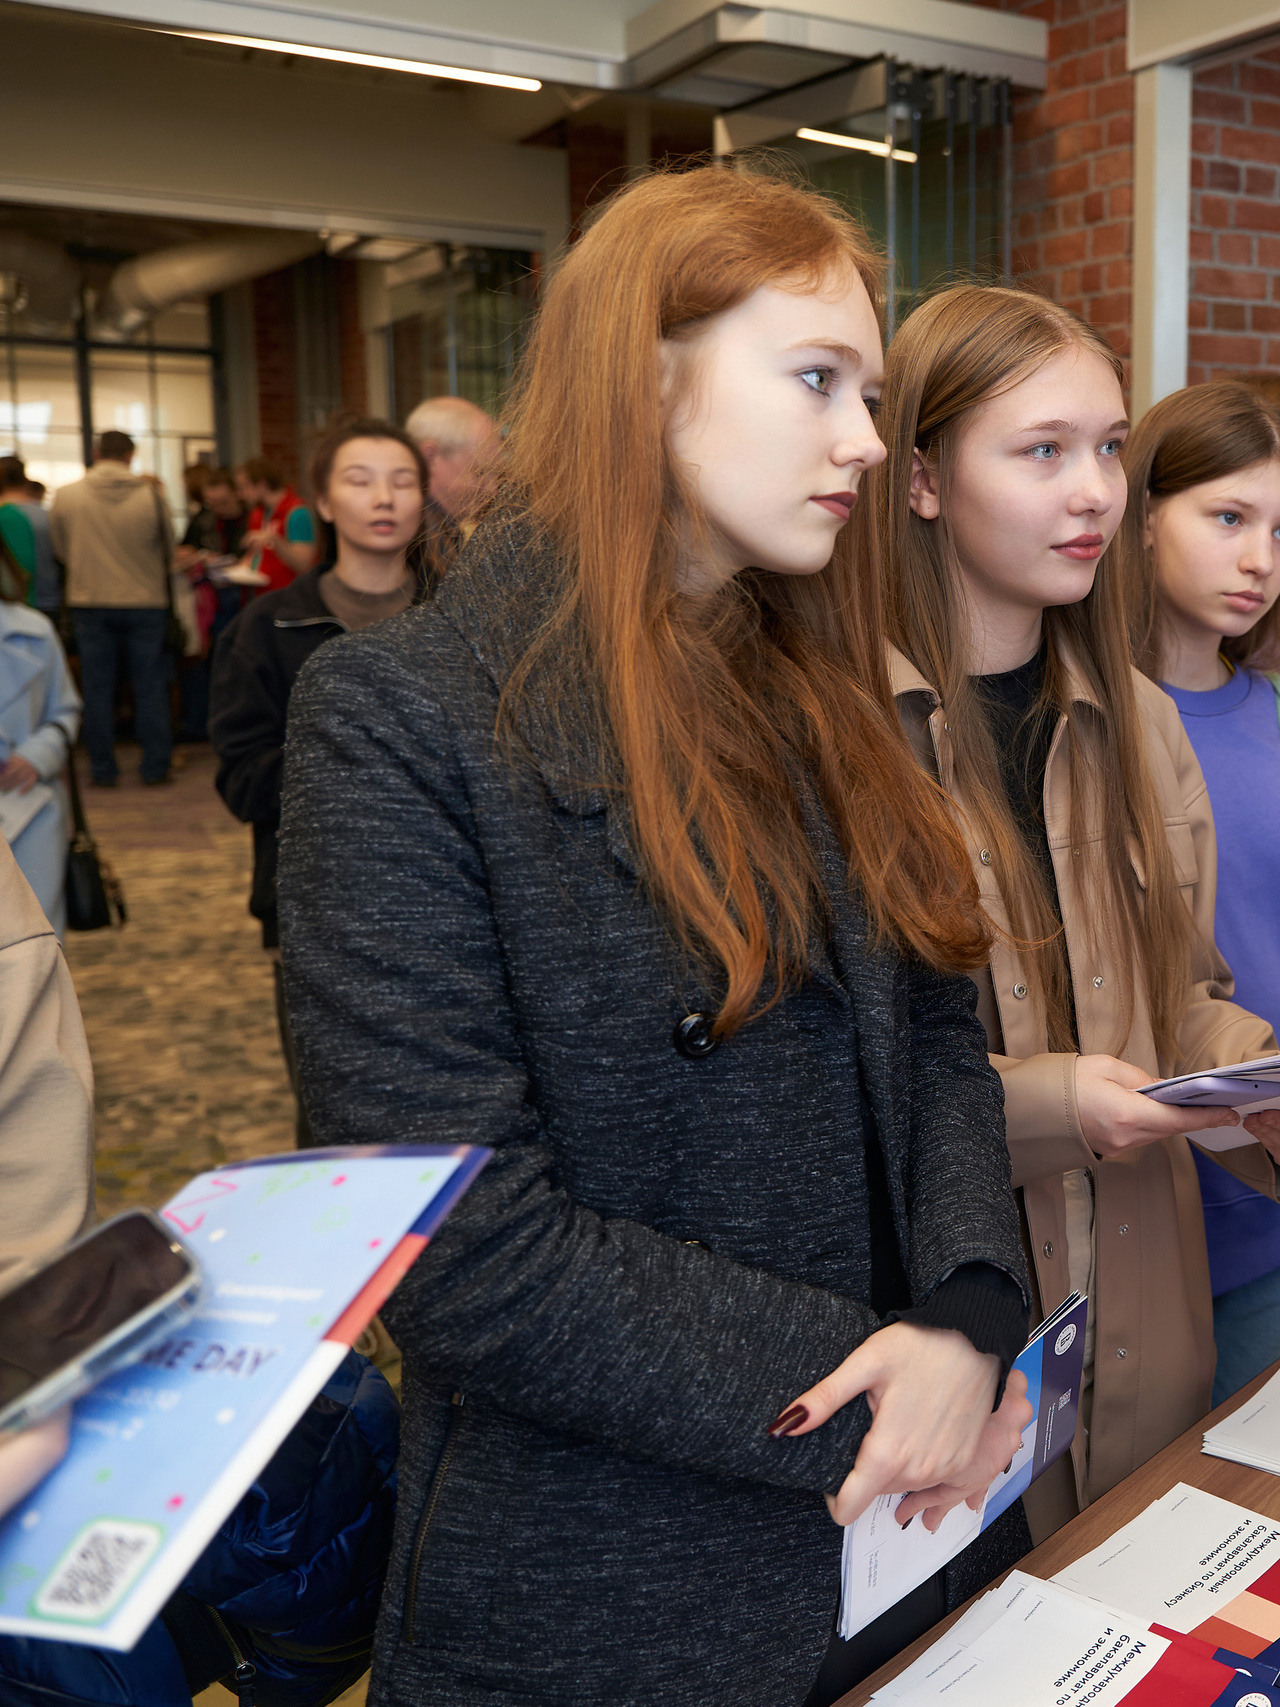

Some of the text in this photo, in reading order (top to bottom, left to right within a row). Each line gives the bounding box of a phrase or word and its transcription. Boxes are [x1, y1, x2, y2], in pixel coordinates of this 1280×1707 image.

[193, 1343, 279, 1376] DAY
[1163, 1524, 1267, 1608] бакалавриат по бизнесу
[1198, 1525, 1245, 1566] экономике
[1207, 1530, 1280, 1593] Международный
[1053, 1627, 1114, 1687] и экономике
[1056, 1634, 1131, 1706] бакалавриат по
[1075, 1640, 1147, 1707] Международн
